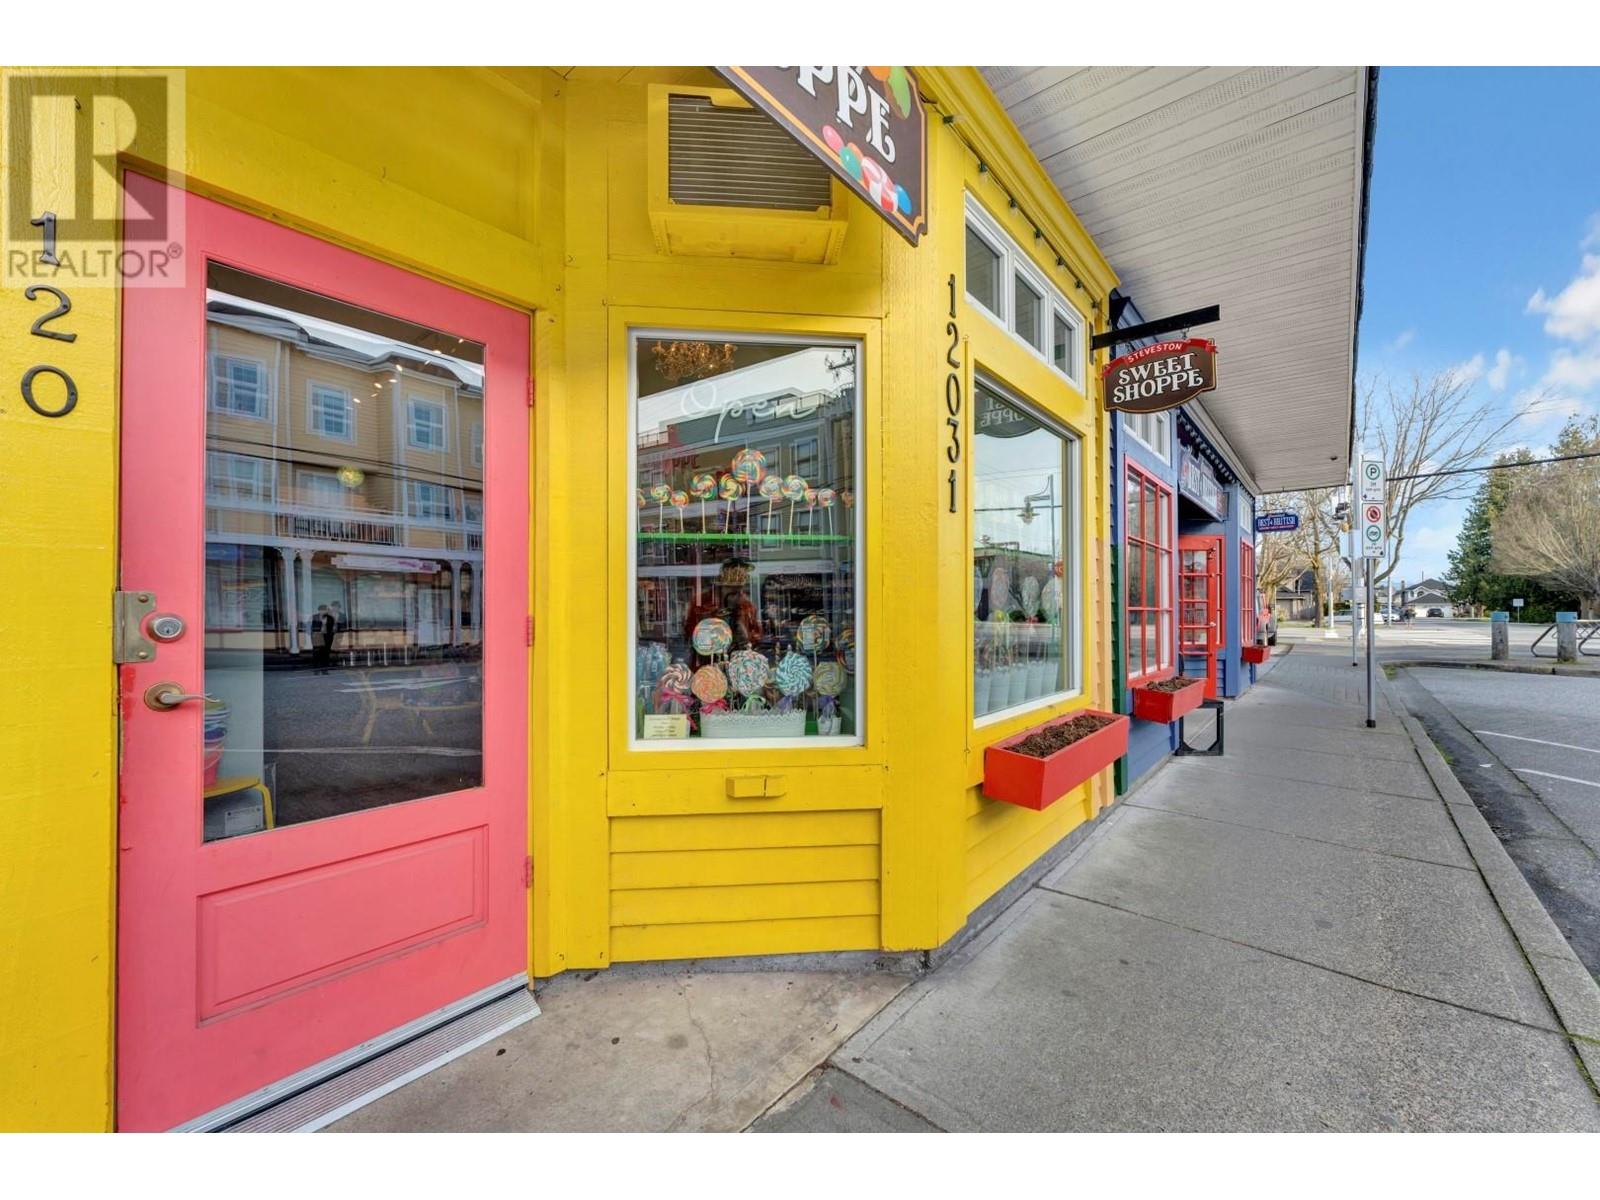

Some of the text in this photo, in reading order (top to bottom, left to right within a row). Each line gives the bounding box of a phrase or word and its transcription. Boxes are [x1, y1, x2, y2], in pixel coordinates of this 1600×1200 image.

[777, 66, 896, 163] PPE
[20, 211, 79, 418] 120
[1113, 368, 1204, 403] SHOPPE
[1118, 352, 1197, 385] SWEET
[1127, 343, 1183, 363] STEVESTON
[946, 273, 961, 513] 12031
